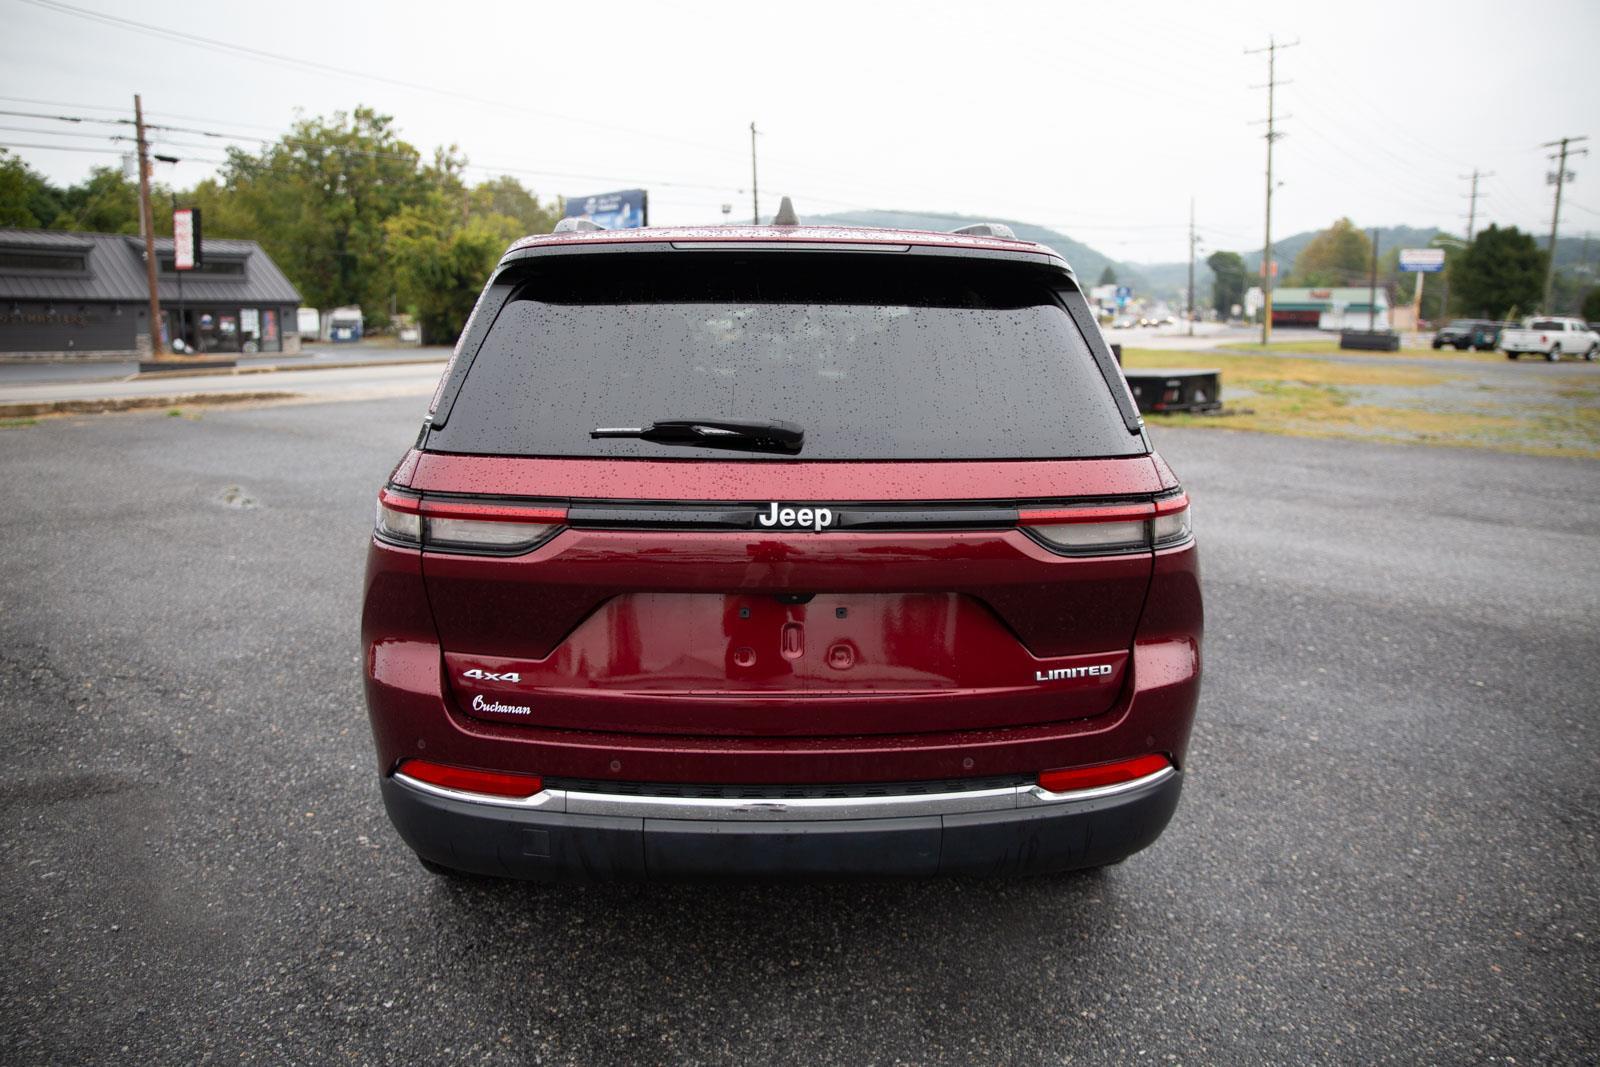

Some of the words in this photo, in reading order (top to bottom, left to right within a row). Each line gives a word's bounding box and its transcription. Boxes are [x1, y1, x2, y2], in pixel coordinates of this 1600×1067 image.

[759, 502, 832, 531] Jeep
[463, 669, 521, 683] 4x4
[1036, 664, 1112, 681] LIMITED
[472, 694, 531, 715] Buchanan
